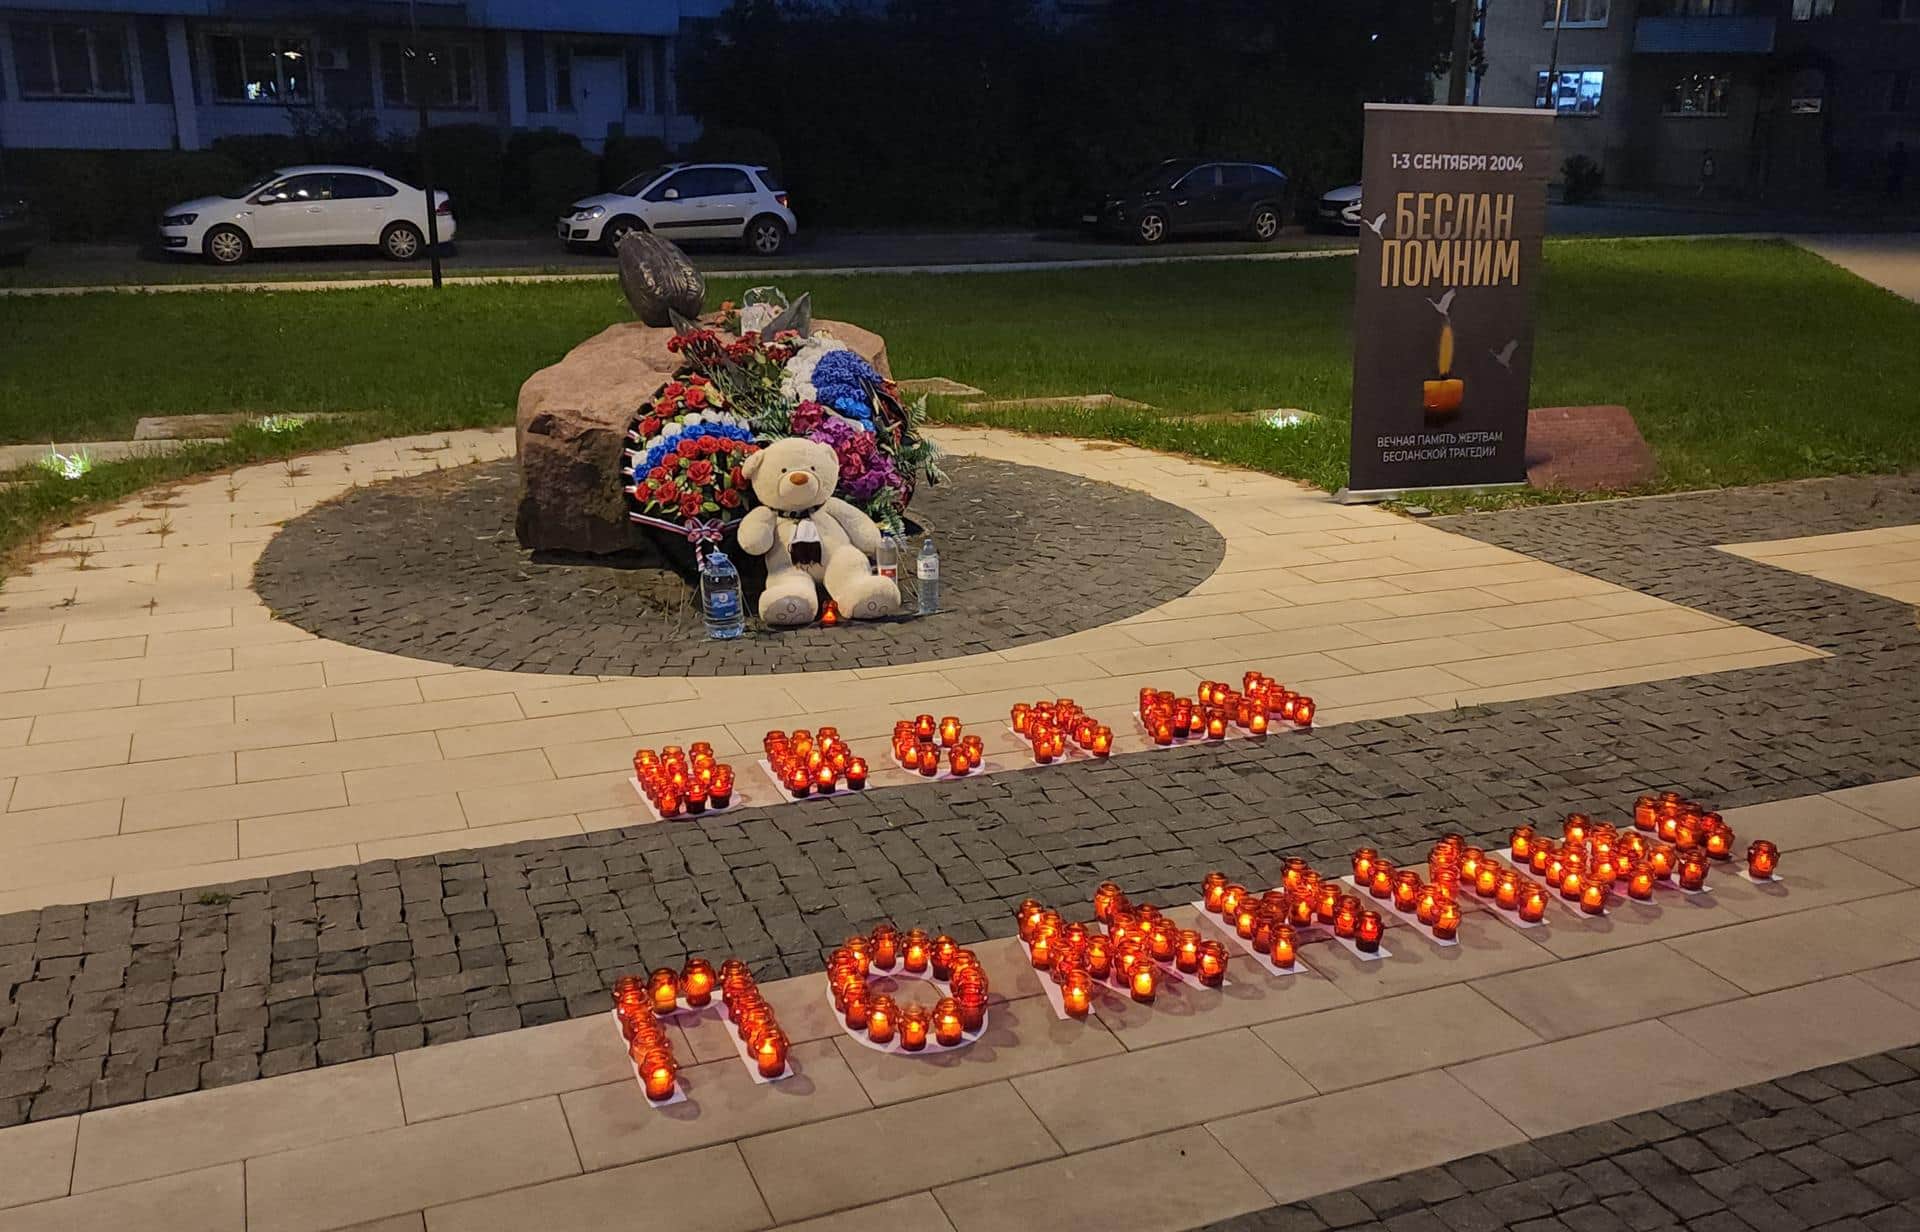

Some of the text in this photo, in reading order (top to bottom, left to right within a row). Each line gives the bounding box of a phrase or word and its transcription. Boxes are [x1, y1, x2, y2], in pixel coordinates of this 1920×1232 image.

[1392, 153, 1524, 171] 1-3 СЕНТЯБРЯ 2004
[1395, 192, 1515, 240] БЕСЛАН
[1381, 239, 1520, 287] ПОМНИМ
[1377, 431, 1503, 447] ВЕЧНАЯ ПАМЯТЬ ЖЕРТВАМ
[1383, 446, 1496, 462] БЕСЛАНСКОЙ ТРАГЕДИИ
